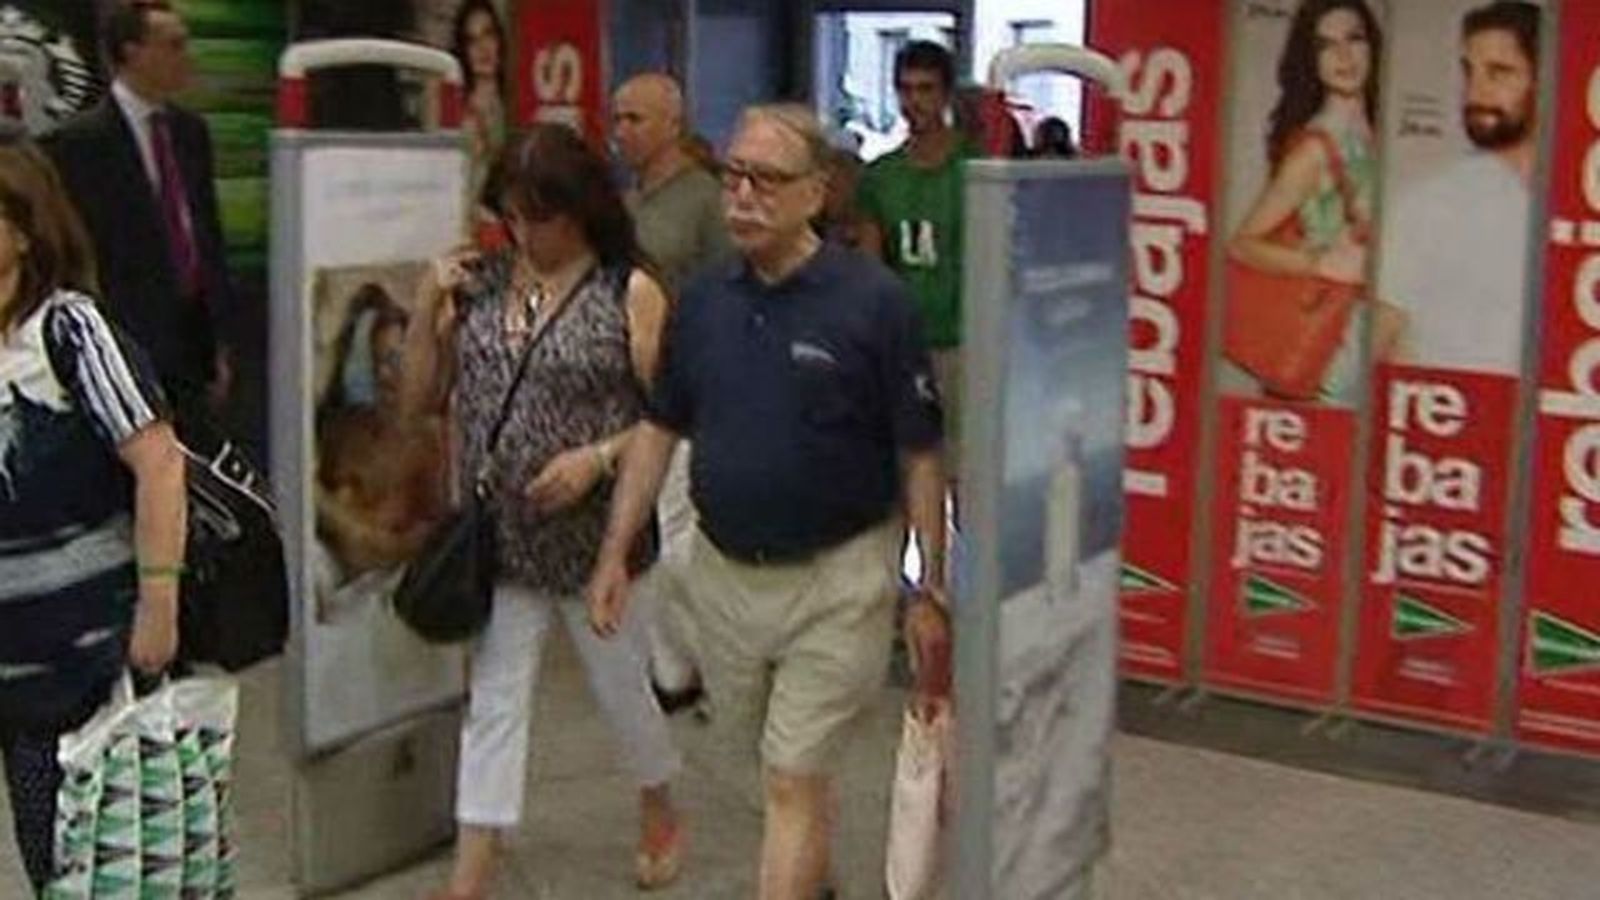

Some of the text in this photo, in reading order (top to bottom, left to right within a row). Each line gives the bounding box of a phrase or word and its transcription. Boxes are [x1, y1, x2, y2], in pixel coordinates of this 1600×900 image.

[900, 219, 938, 267] LA
[1244, 406, 1306, 451] re
[1387, 378, 1467, 438] re
[1239, 449, 1320, 513] ba
[1384, 430, 1482, 513] ba
[1230, 503, 1324, 570] jas
[1370, 502, 1491, 586] jas
